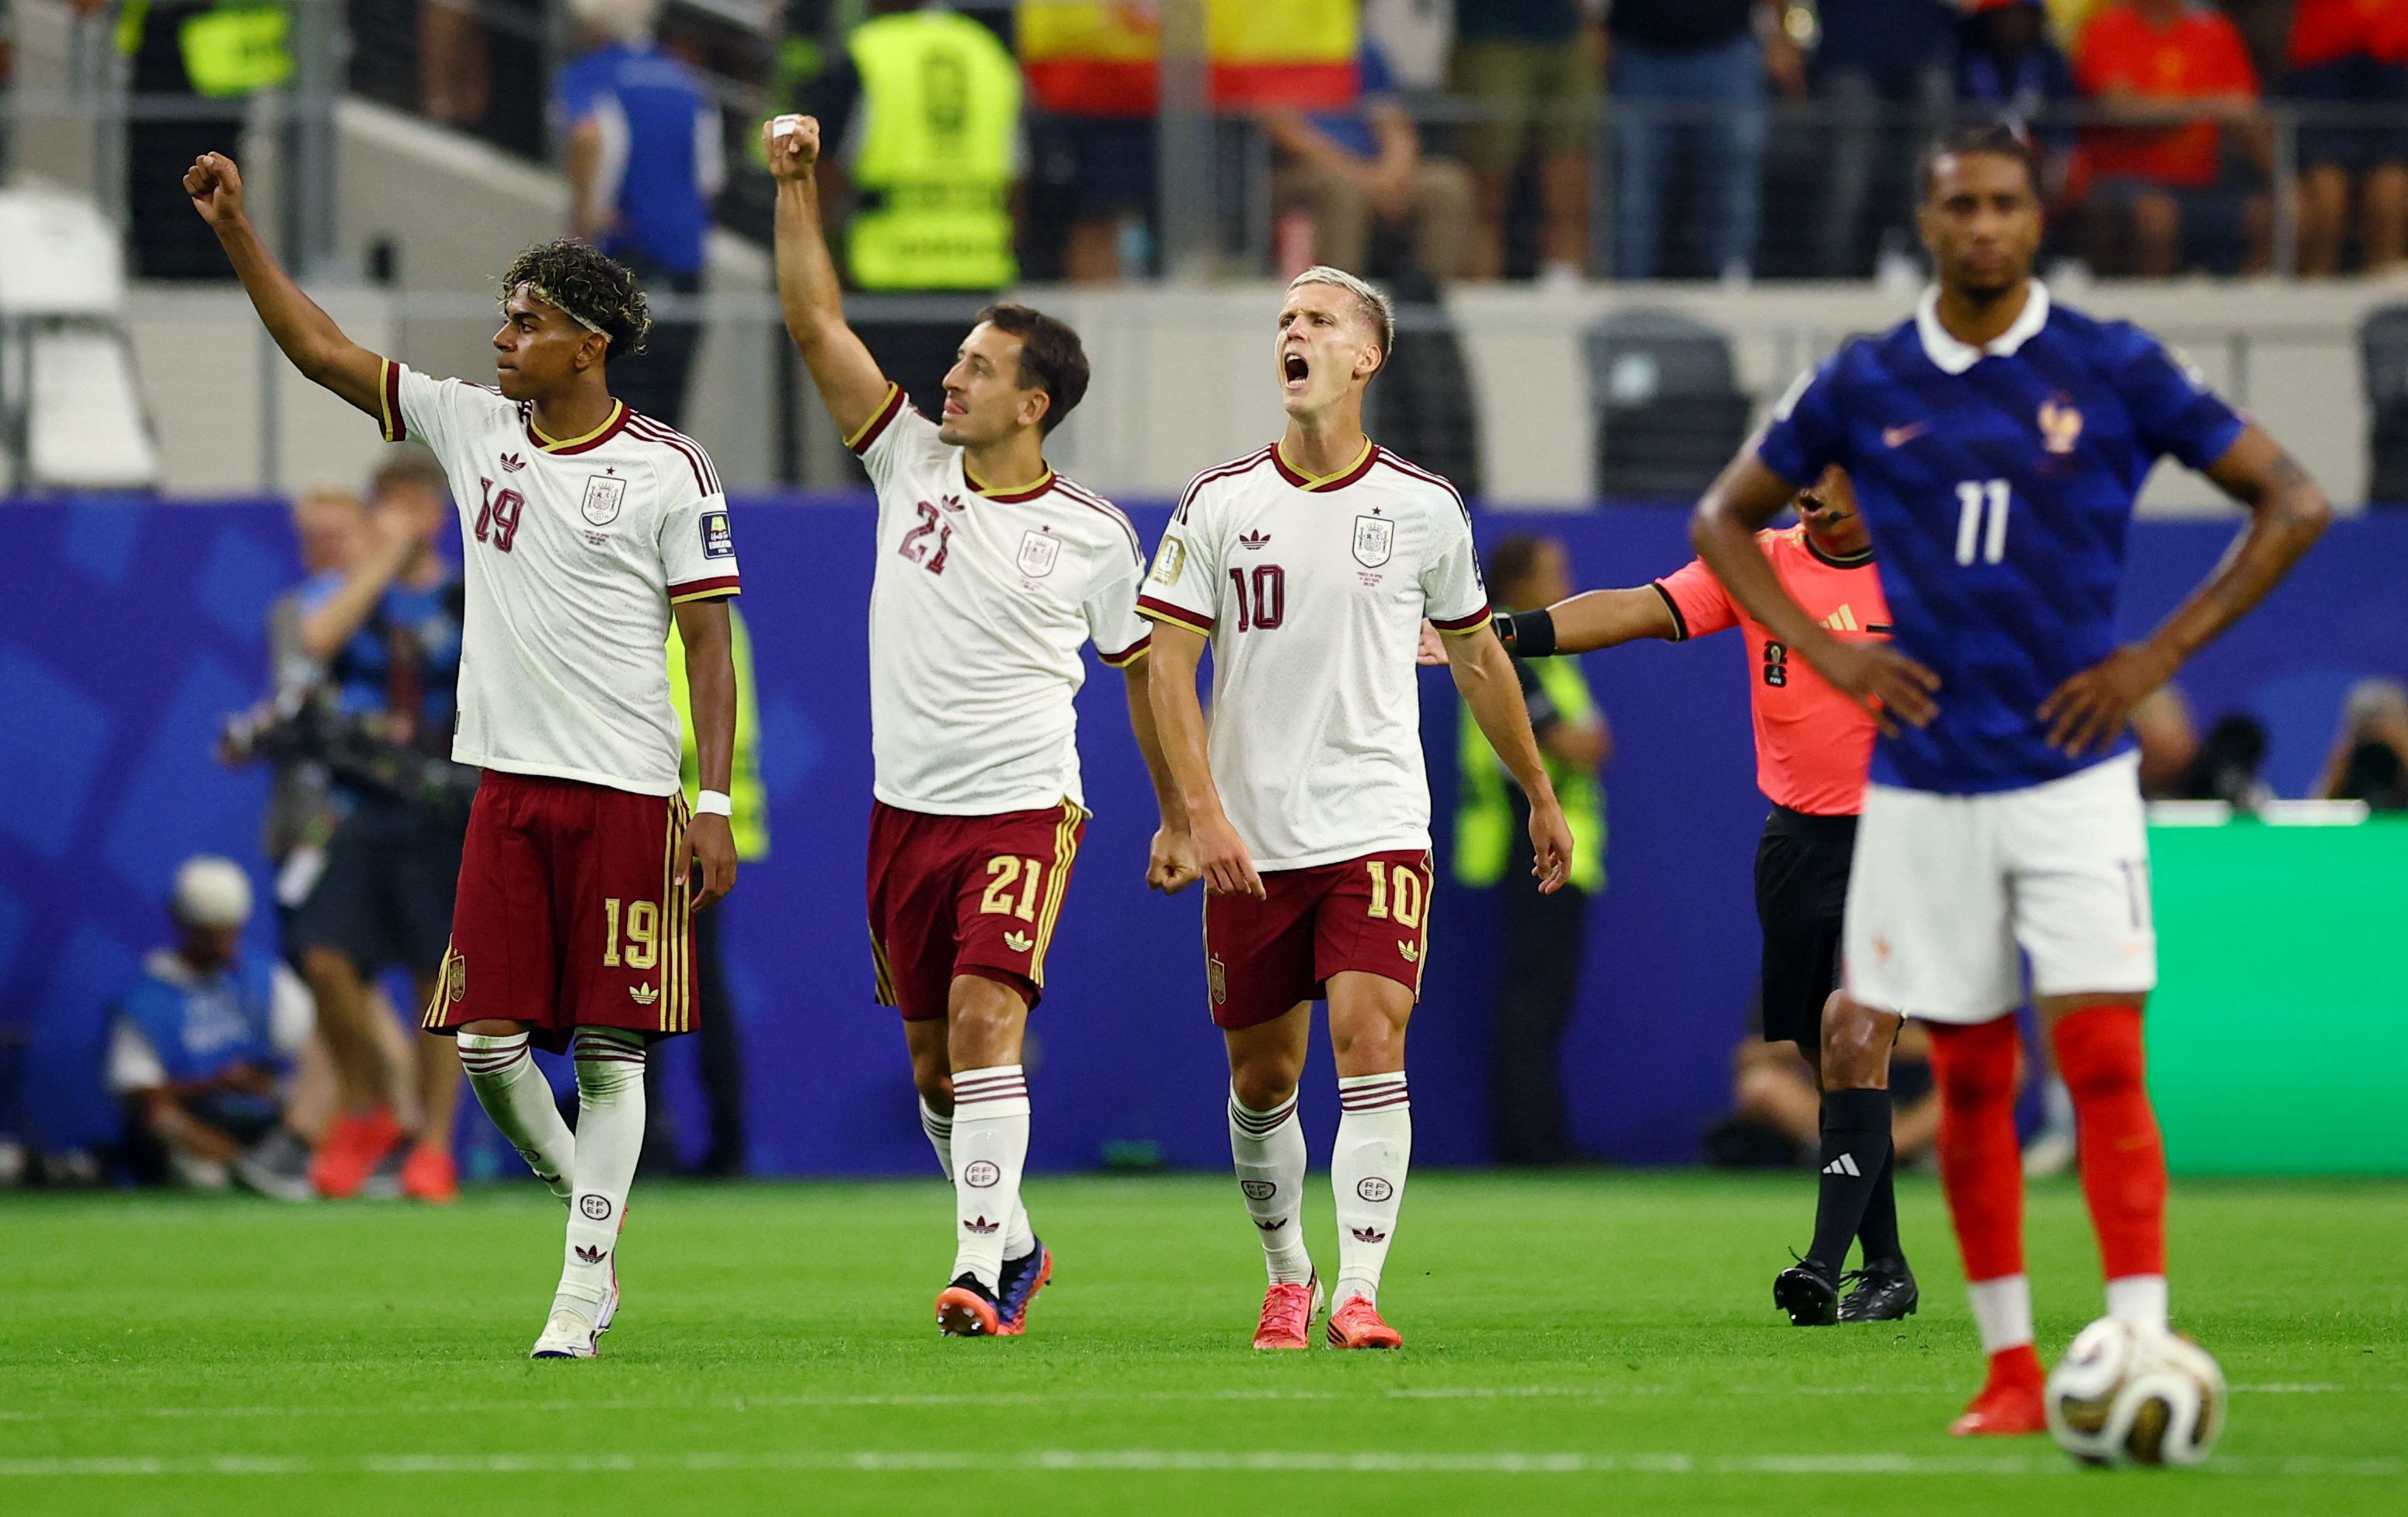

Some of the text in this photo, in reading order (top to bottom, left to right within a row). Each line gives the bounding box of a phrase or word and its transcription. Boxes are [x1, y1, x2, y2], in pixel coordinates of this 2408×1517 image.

[475, 475, 525, 554] 19
[897, 501, 952, 576] 21
[1955, 478, 2010, 565] 11
[1229, 564, 1285, 633] 10
[980, 855, 1042, 923] 21
[1367, 861, 1421, 929] 10
[604, 898, 659, 969] 19
